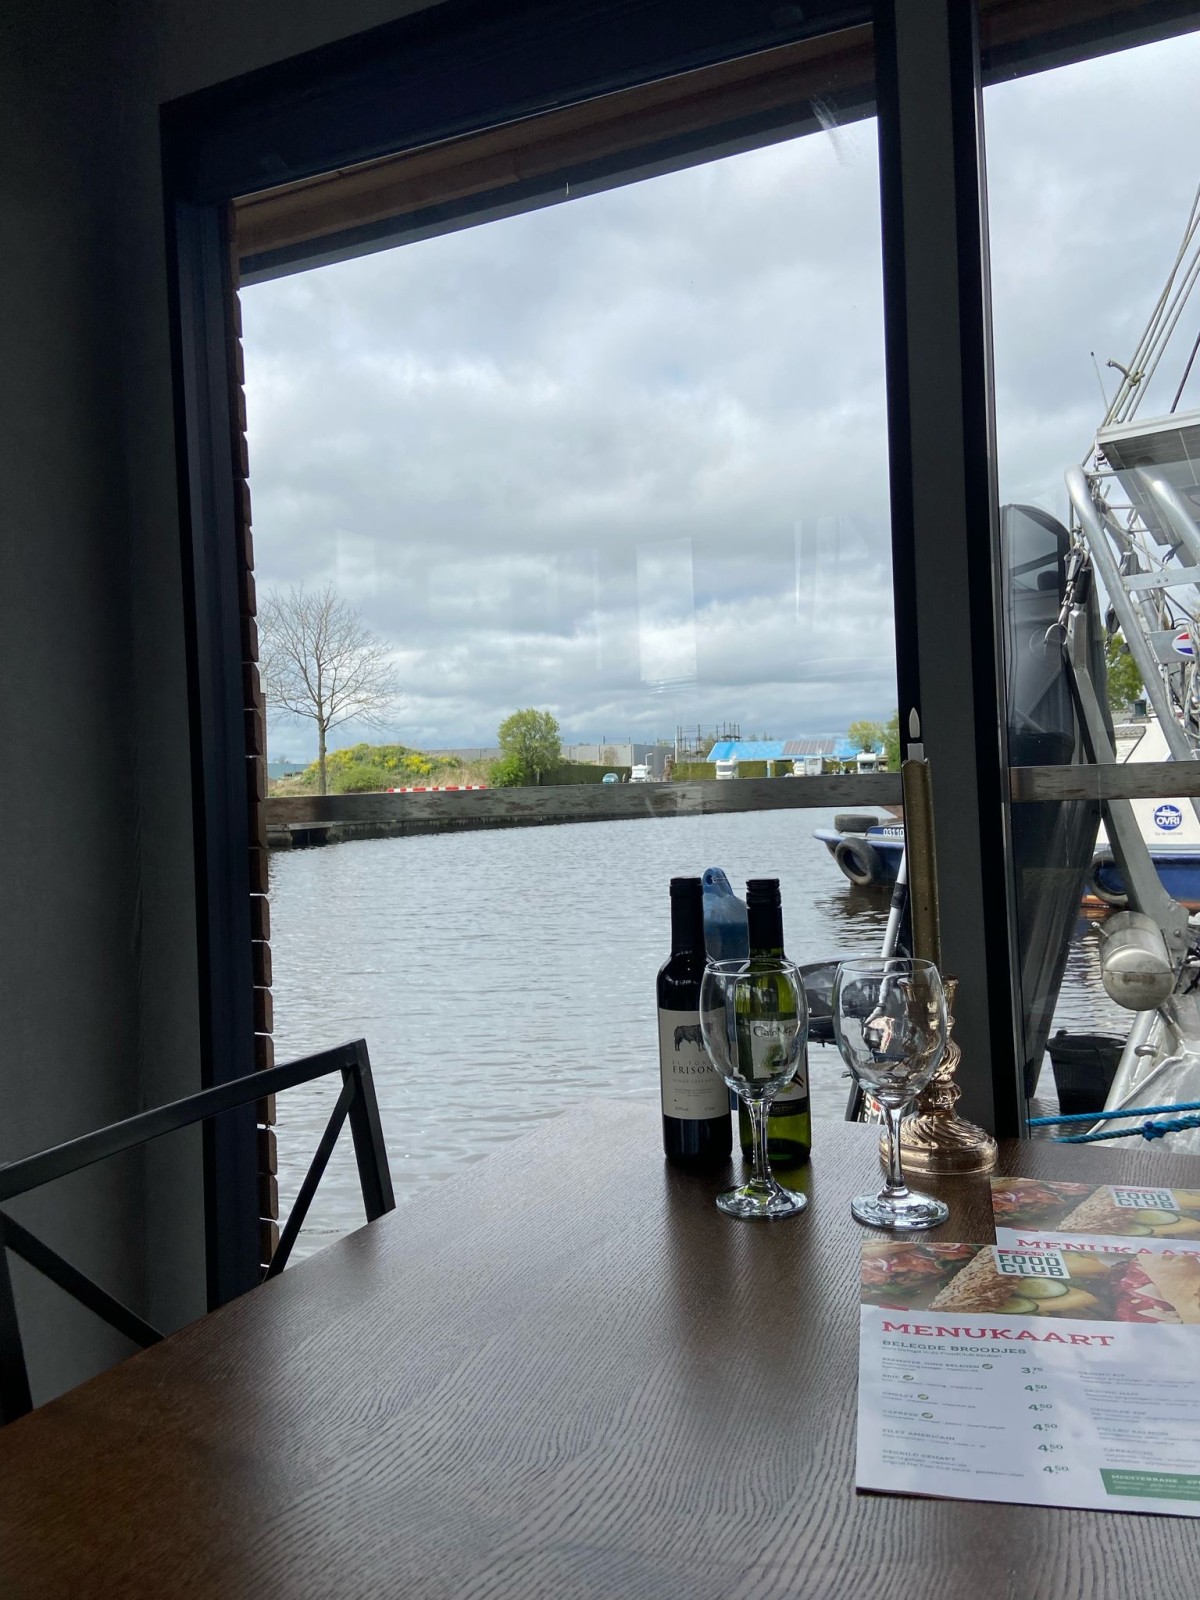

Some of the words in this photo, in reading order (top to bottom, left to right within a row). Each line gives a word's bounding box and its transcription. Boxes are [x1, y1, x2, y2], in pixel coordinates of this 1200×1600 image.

[1156, 816, 1181, 825] OVRI
[672, 1066, 713, 1074] FRISON
[1114, 1192, 1171, 1202] FOOD
[1118, 1199, 1175, 1209] CLUB
[998, 1254, 1061, 1266] FOOD
[1001, 1264, 1064, 1276] CLUB
[882, 1321, 1115, 1347] MENUKAART
[882, 1340, 947, 1351] BELEGDE
[950, 1345, 1027, 1355] BROODJES
